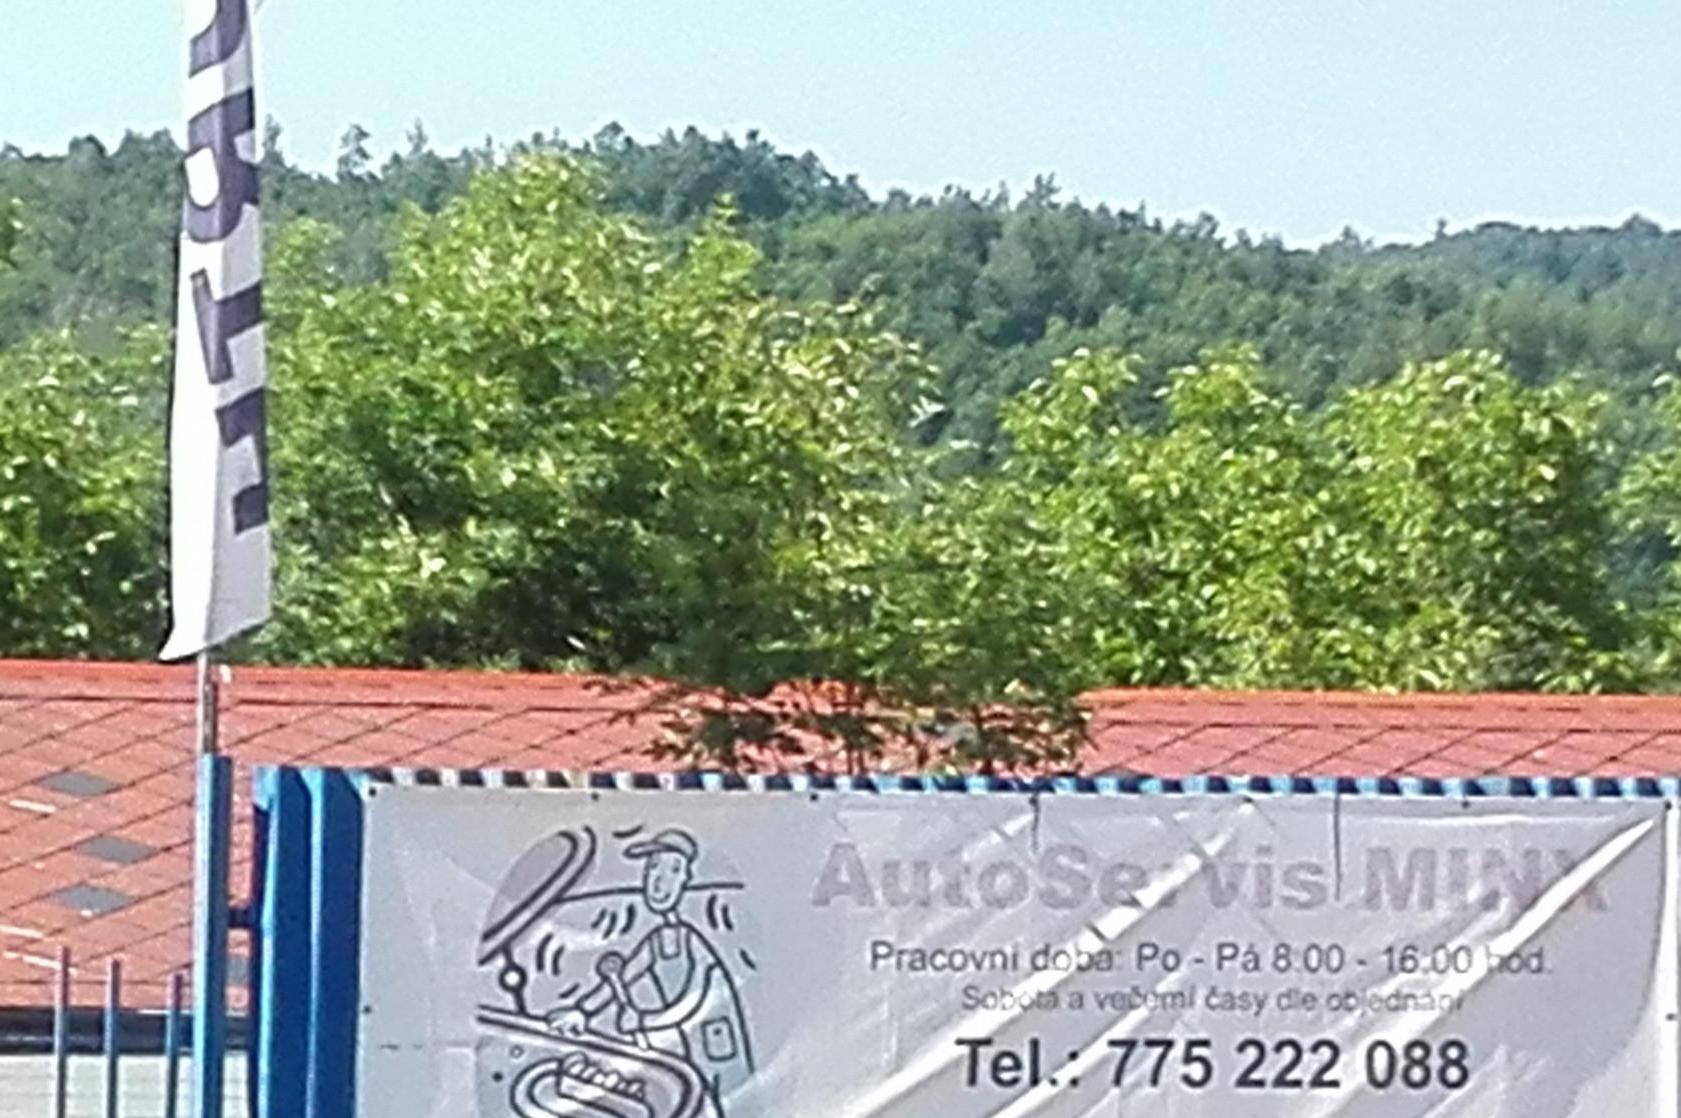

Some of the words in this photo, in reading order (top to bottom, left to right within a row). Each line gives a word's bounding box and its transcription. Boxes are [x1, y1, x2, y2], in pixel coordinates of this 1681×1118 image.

[812, 843, 1328, 910] AutoSevis
[1363, 847, 1608, 912] MINX
[870, 939, 1018, 973] Pracovní
[1136, 941, 1182, 973] Po
[1215, 941, 1262, 975] Pá
[961, 984, 1061, 1011] Sobota
[1067, 989, 1086, 1010] a
[1276, 985, 1318, 1012] dle
[954, 1036, 1080, 1089] Tel.:
[1106, 1037, 1214, 1089] 775
[1234, 1036, 1341, 1089] 222
[1365, 1037, 1470, 1091] 088
